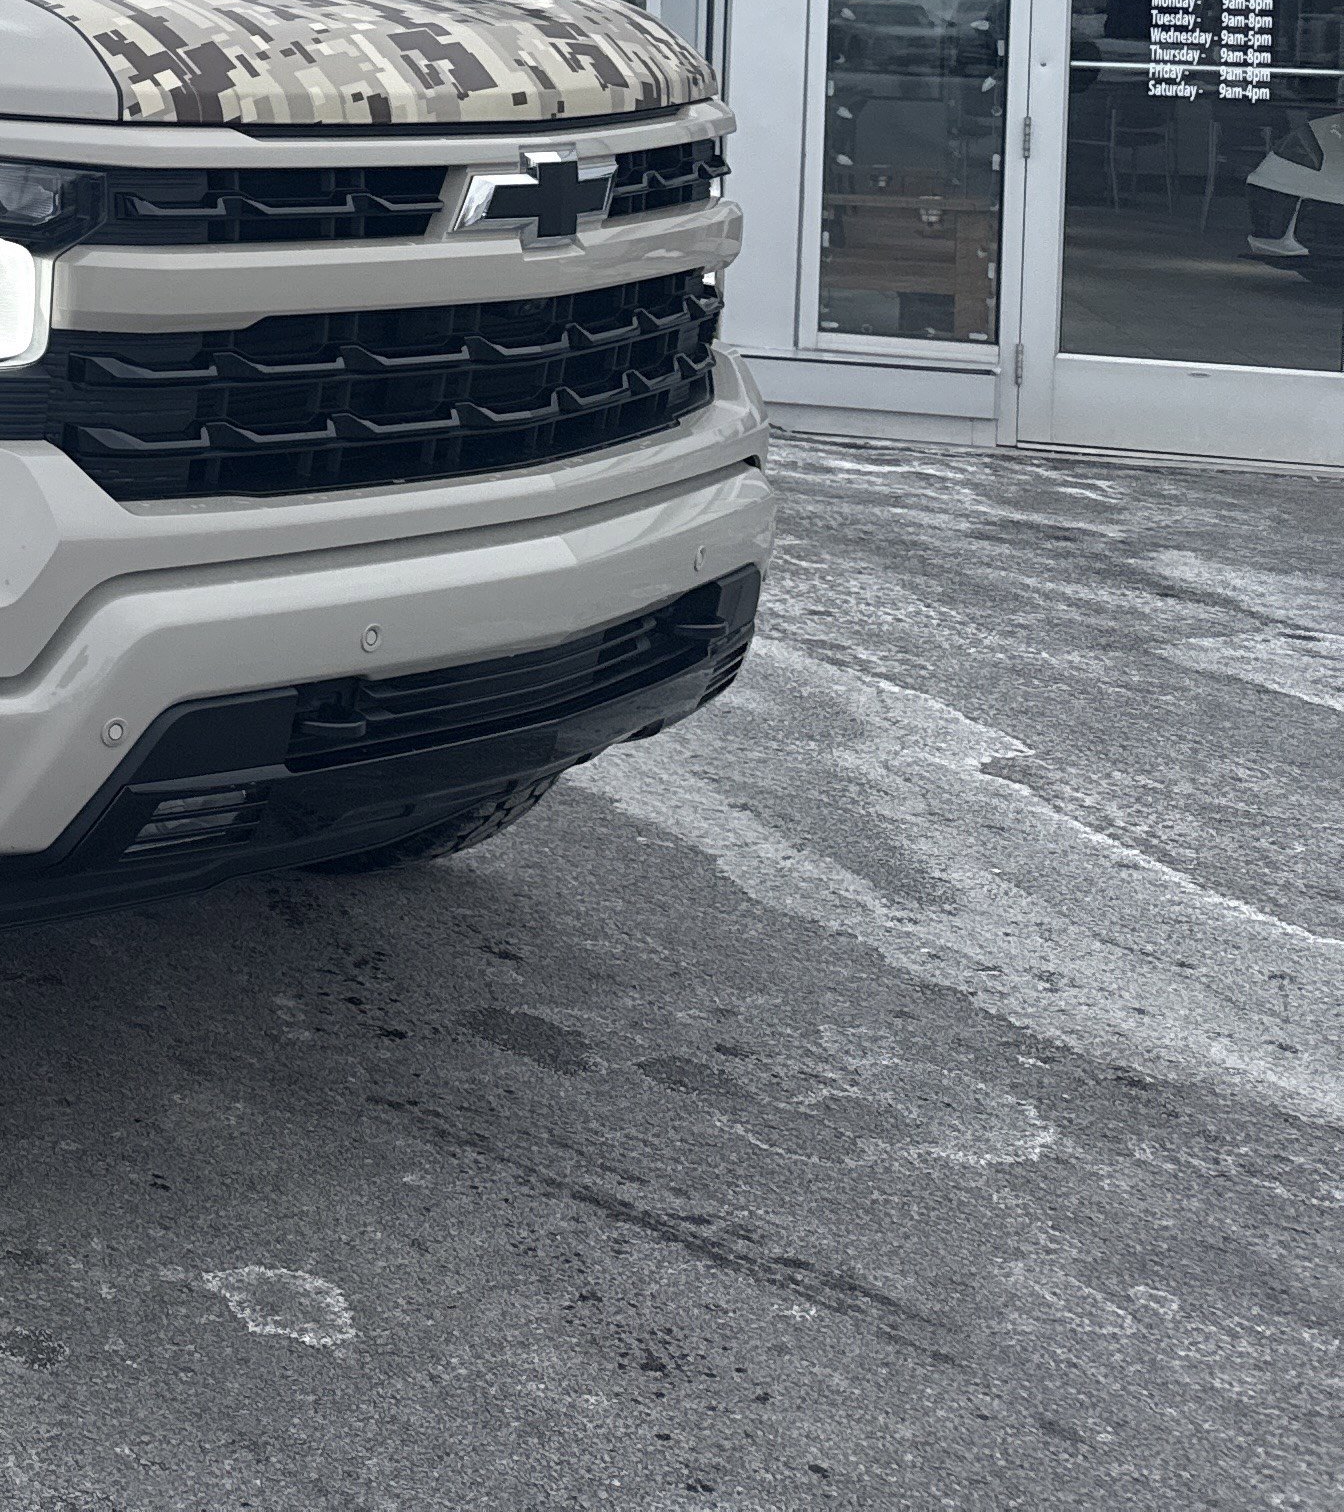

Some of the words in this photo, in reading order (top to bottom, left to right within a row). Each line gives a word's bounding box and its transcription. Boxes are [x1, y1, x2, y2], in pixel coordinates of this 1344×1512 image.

[1221, 12, 1273, 31] 9am-8pm
[1220, 30, 1272, 49] 9am-5pm
[1220, 48, 1272, 67] 9am-8pm
[1219, 83, 1270, 103] 9am-4pm
